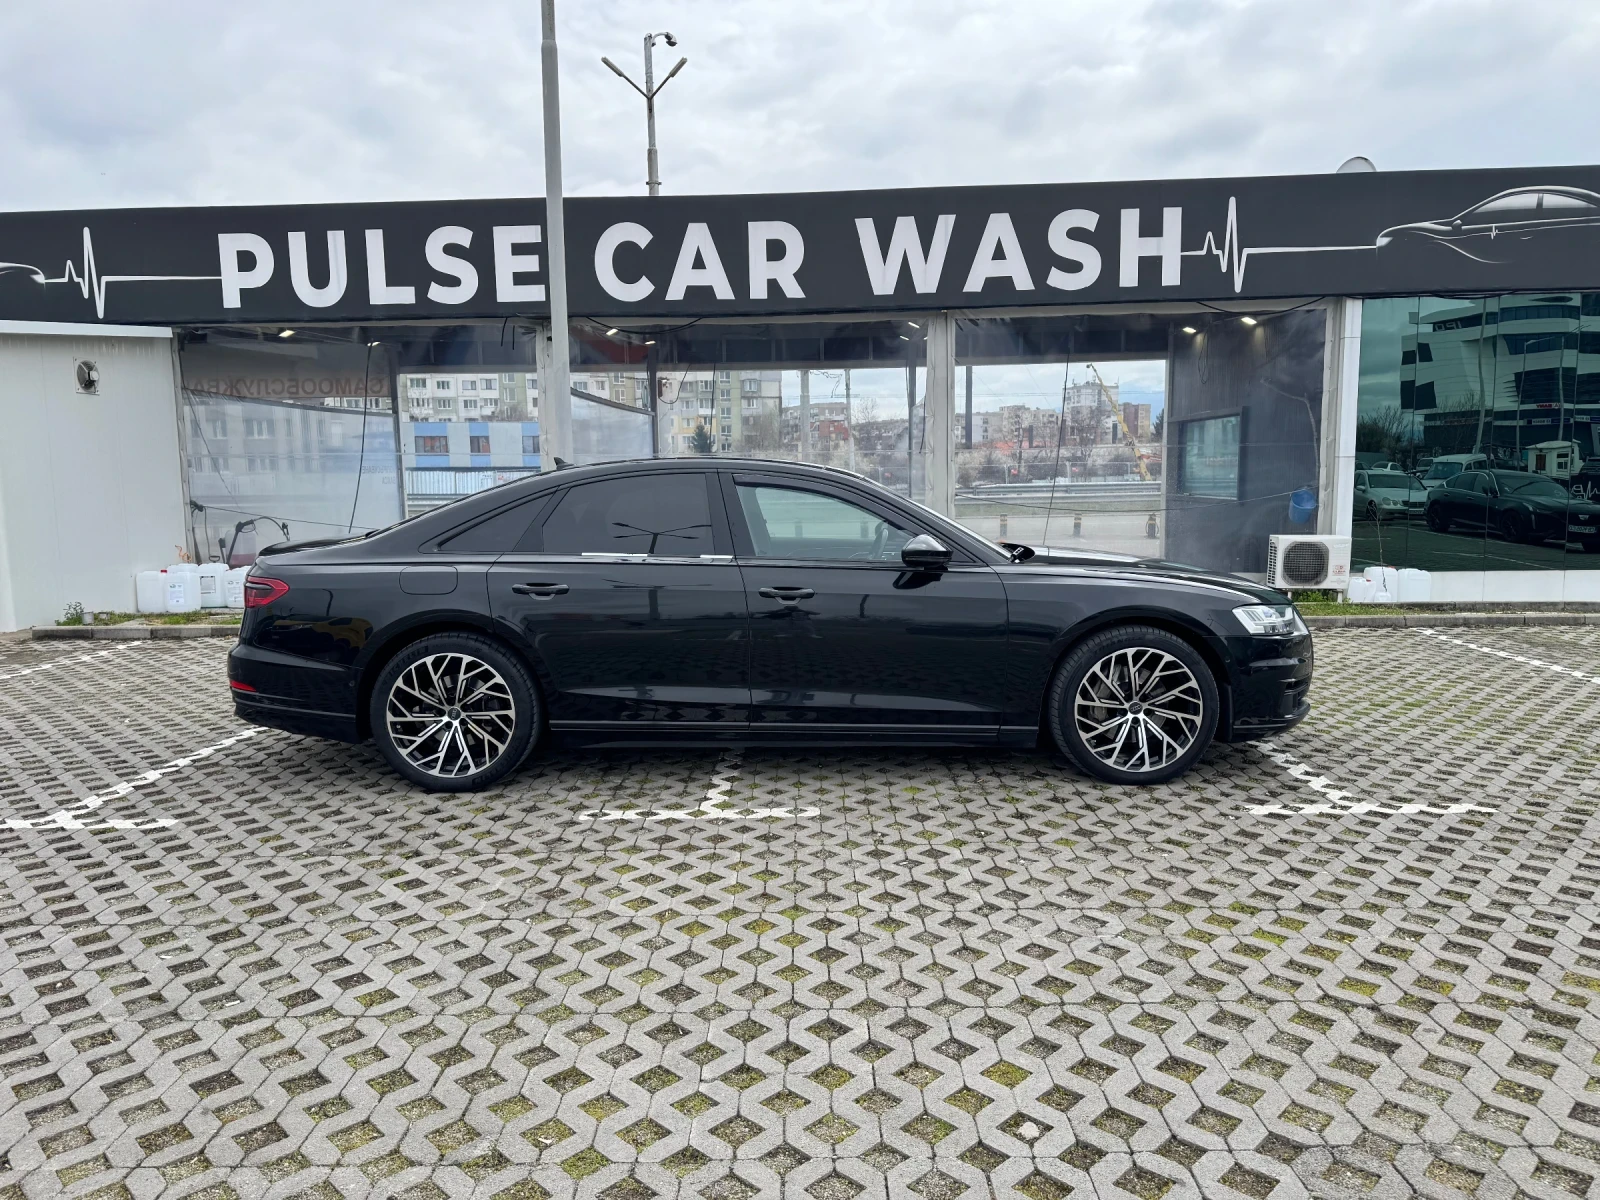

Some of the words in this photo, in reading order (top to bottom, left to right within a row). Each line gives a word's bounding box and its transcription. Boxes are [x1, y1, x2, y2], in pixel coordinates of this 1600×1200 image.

[218, 225, 546, 308] PULSE
[594, 220, 807, 302] CAR
[854, 207, 1182, 295] WASH
